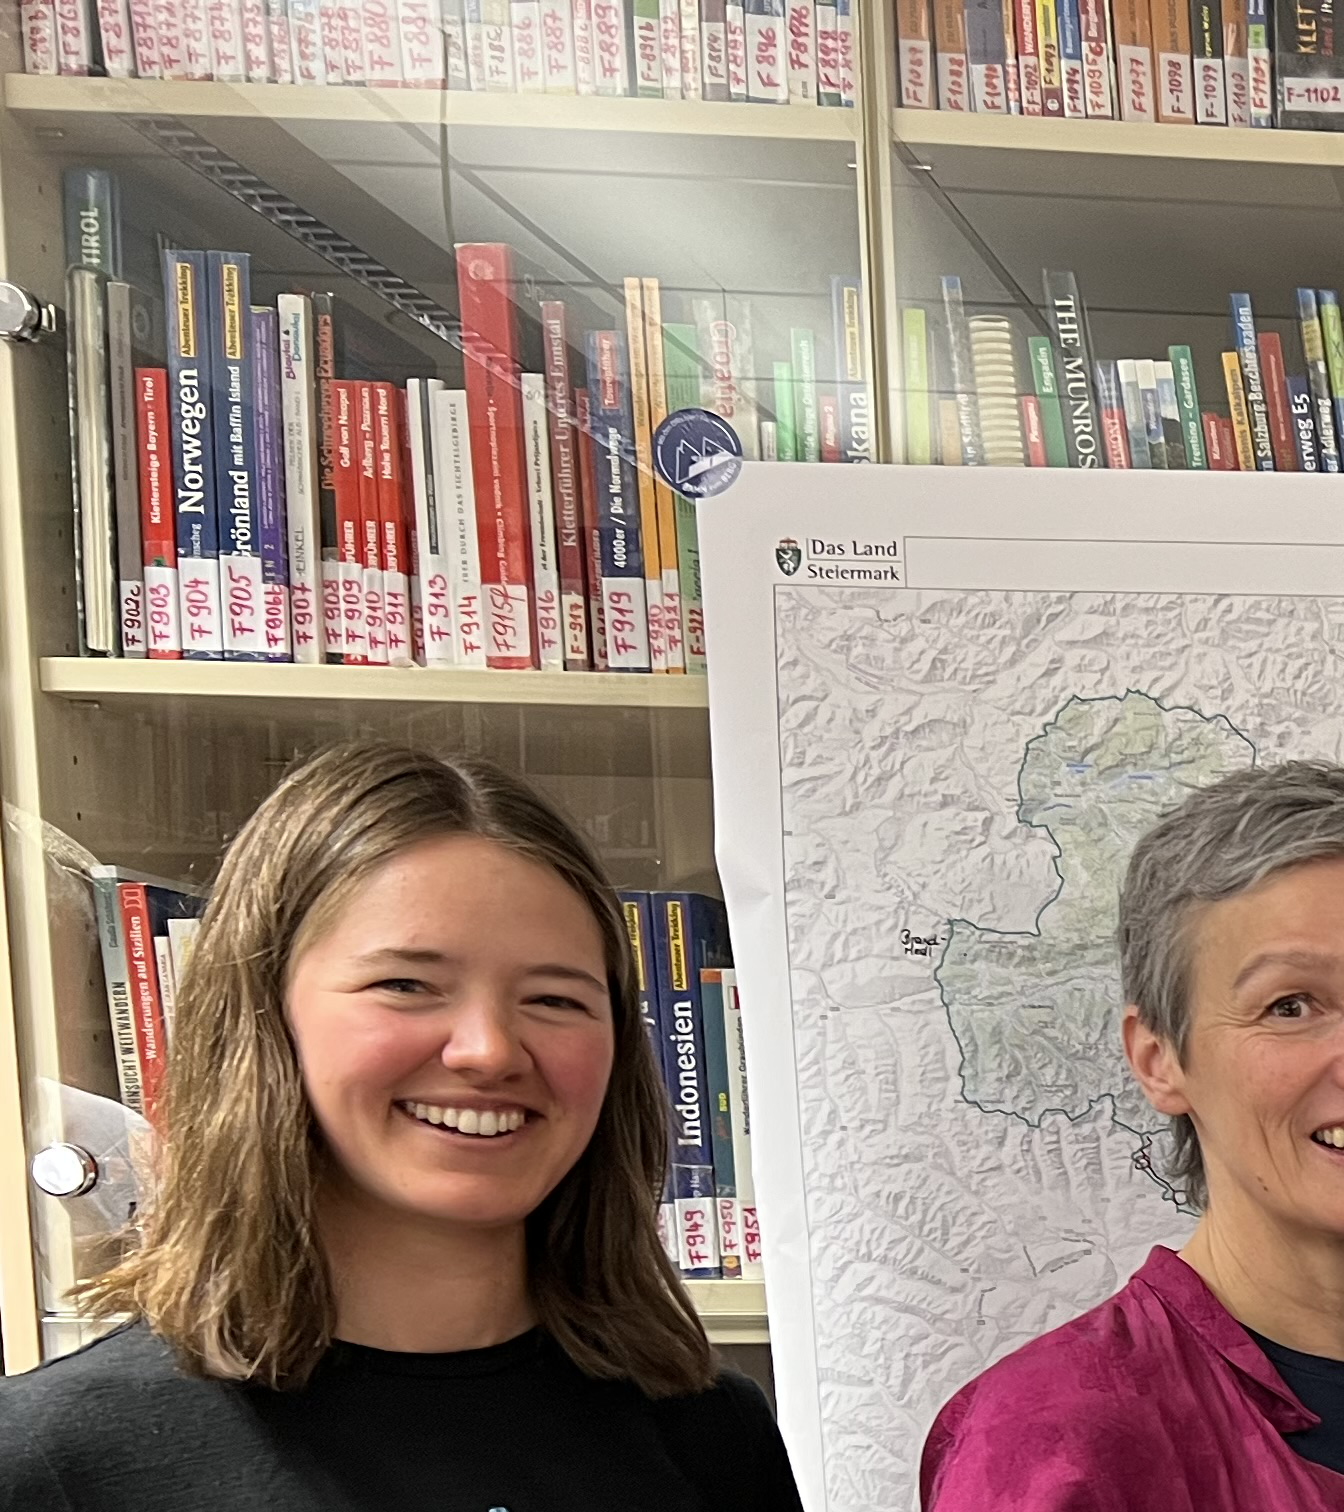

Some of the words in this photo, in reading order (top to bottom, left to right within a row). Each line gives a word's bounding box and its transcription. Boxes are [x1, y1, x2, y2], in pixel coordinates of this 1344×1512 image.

[1285, 85, 1341, 103] F-1102
[80, 207, 101, 266] TIROL
[179, 265, 190, 305] Trekking
[180, 309, 193, 356] Abenteuer
[1054, 294, 1082, 348] THE
[228, 366, 240, 404] Island
[230, 406, 242, 443] Baffin
[1063, 356, 1099, 469] MUNROS
[178, 368, 206, 514] Norwegen
[232, 442, 244, 466] mit
[811, 539, 845, 556] Das
[852, 540, 897, 557] Land
[807, 564, 900, 581] Steiermark
[129, 915, 144, 957] Sizilien
[667, 902, 680, 943] Trekking
[132, 960, 147, 979] auf
[672, 945, 685, 990] Abenteuer
[111, 981, 132, 1056] WEITWANDERN
[137, 982, 158, 1061] Wanderungen
[668, 1000, 703, 1148] Indonesien
